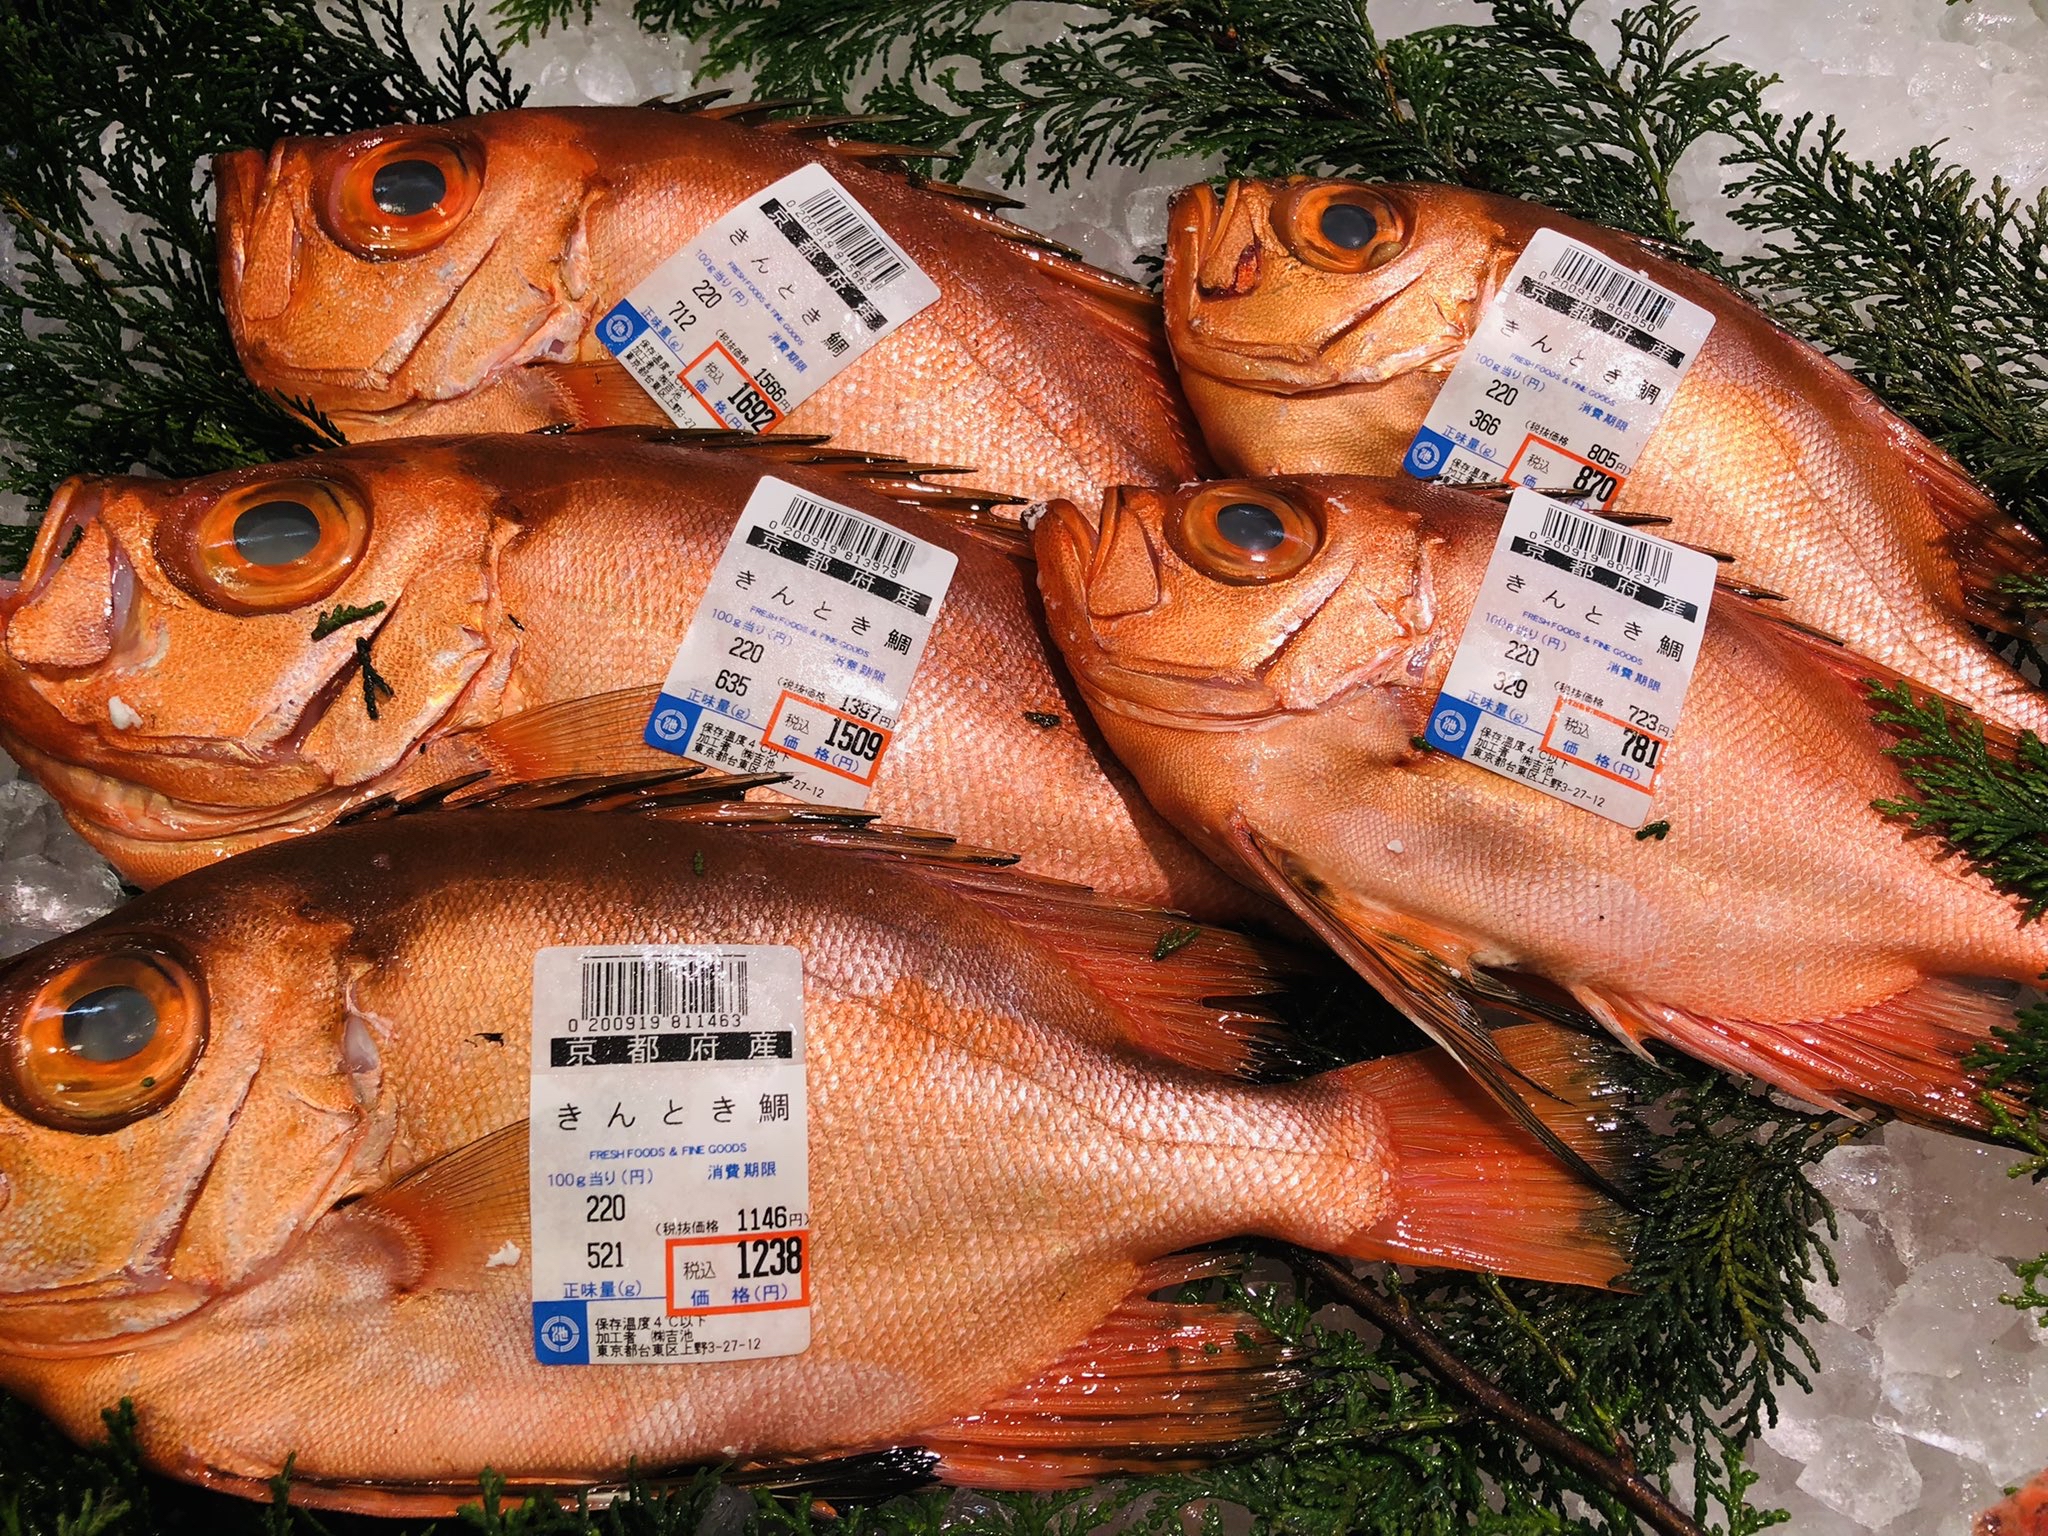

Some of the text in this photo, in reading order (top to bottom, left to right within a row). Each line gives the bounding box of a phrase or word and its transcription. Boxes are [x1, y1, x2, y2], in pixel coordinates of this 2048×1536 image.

[785, 199, 873, 292] 0 200919 815669
[766, 205, 881, 325] 京都府産
[689, 278, 724, 309] 220
[725, 225, 852, 358] きんとき鯛
[726, 260, 806, 346] FRESH FOODS & FINE GOODS
[1538, 270, 1656, 332] 0 200919 808050
[638, 305, 687, 352] 正味量(g)
[664, 299, 699, 331] 712
[1526, 282, 1676, 363] 京都府産
[766, 330, 809, 373] 消費期限
[700, 360, 779, 432] 税込 1692
[1484, 378, 1519, 406] 220
[1508, 352, 1534, 368] FRESH
[1533, 363, 1561, 380] FOODS
[1569, 381, 1588, 393] FINE
[1587, 389, 1617, 407] GOODS
[1467, 408, 1502, 436] 366
[1577, 401, 1629, 432] 消費期限
[1441, 424, 1499, 458] 正味量(g)
[1525, 453, 1619, 503] 税込 870
[768, 520, 898, 579] 0 200919 813979
[1528, 530, 1660, 588] 0 200919 807237
[757, 530, 921, 611] 京都府産
[1521, 540, 1688, 618] 京都府産
[734, 567, 913, 655] きんとき鯛
[1504, 572, 1684, 662] きんとき鯛
[728, 636, 765, 664] 220
[749, 605, 870, 658] FRESH FOODS & FINE GOODS
[1522, 610, 1644, 666] FRESH FOODS & FINE GOODS
[1504, 639, 1539, 668] 220
[713, 669, 751, 697] 635
[1492, 670, 1528, 700] 329
[1606, 660, 1661, 692] 消費期限
[686, 688, 752, 721] 正味量(g)
[1465, 689, 1529, 726] 正味量(g)
[697, 733, 731, 752] 加工者
[783, 713, 885, 762] 税込 1509
[1474, 737, 1510, 758] 加工者
[1562, 716, 1661, 769] 税込 781
[568, 1014, 740, 1031] 0 200919 811463
[566, 1032, 778, 1065] 京都府産
[558, 1093, 789, 1130] きんとき鯛
[589, 1142, 746, 1159] FRESH FOODS & FINE GOODS
[707, 1161, 775, 1180] 消費期限
[586, 1194, 625, 1222] 220
[587, 1241, 622, 1268] 521
[683, 1236, 802, 1280] 税込 1238
[563, 1280, 641, 1298] 正味量(g)
[595, 1331, 634, 1345] 加工者
